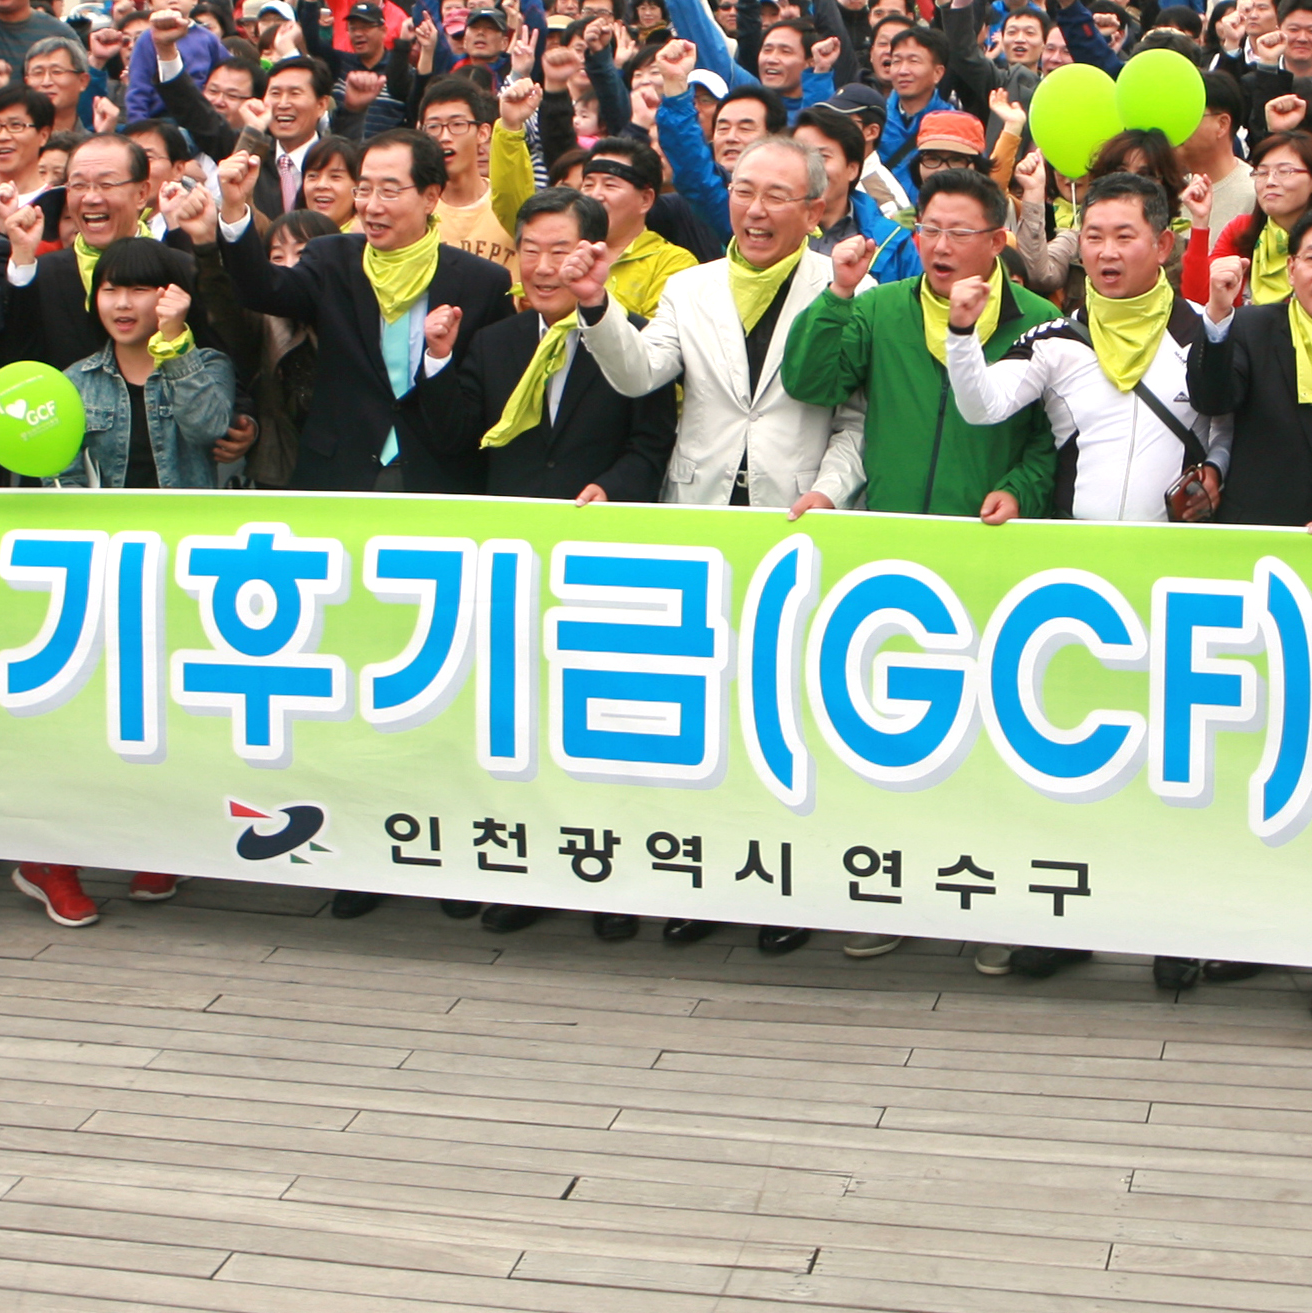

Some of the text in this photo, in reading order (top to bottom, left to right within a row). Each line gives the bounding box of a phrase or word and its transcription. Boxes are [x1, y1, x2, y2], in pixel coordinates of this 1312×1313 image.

[460, 240, 516, 265] DEPT
[26, 400, 57, 426] GCF
[384, 812, 1092, 917] 인천광역시 연수구
